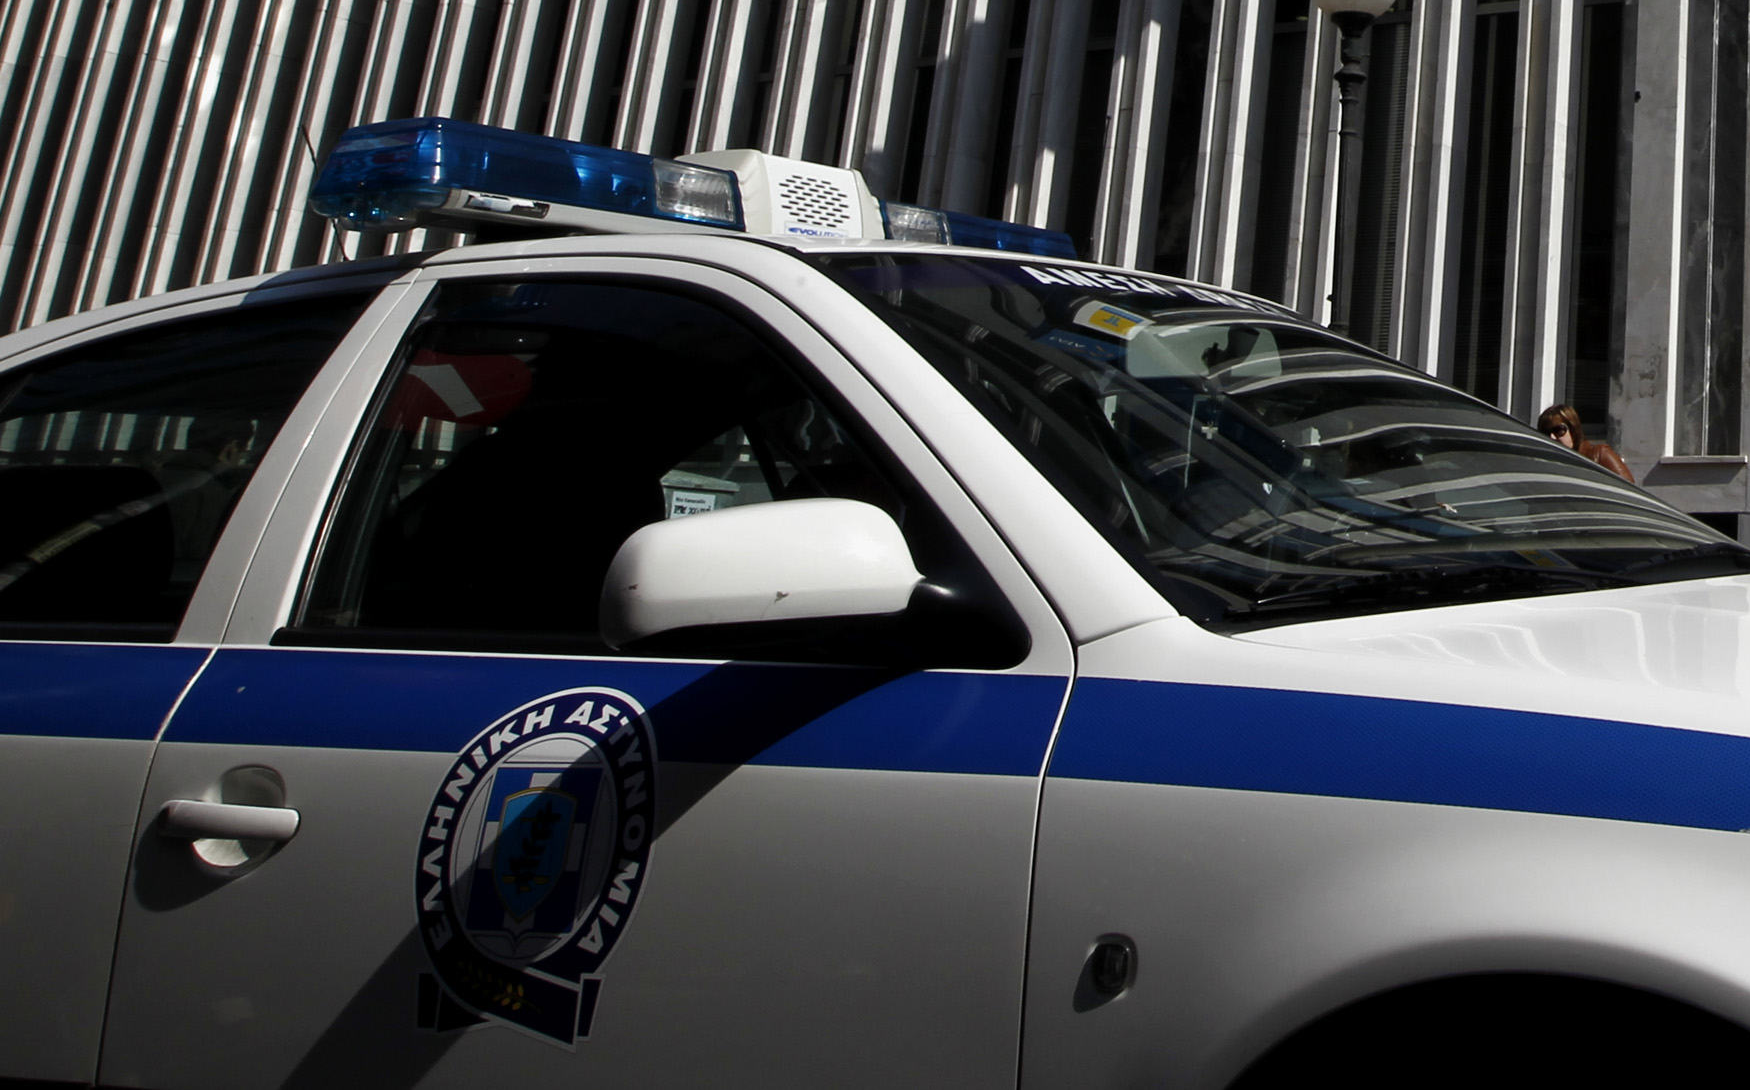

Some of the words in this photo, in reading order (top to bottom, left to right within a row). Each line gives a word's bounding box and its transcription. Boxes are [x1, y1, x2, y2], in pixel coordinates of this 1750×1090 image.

[1019, 265, 1178, 298] ΑΜΕΣΗ
[422, 703, 556, 952] ΕΛΛΗΝΙΚΗ
[563, 699, 648, 956] ΑΣΤΥΝΟΜΙΑ
